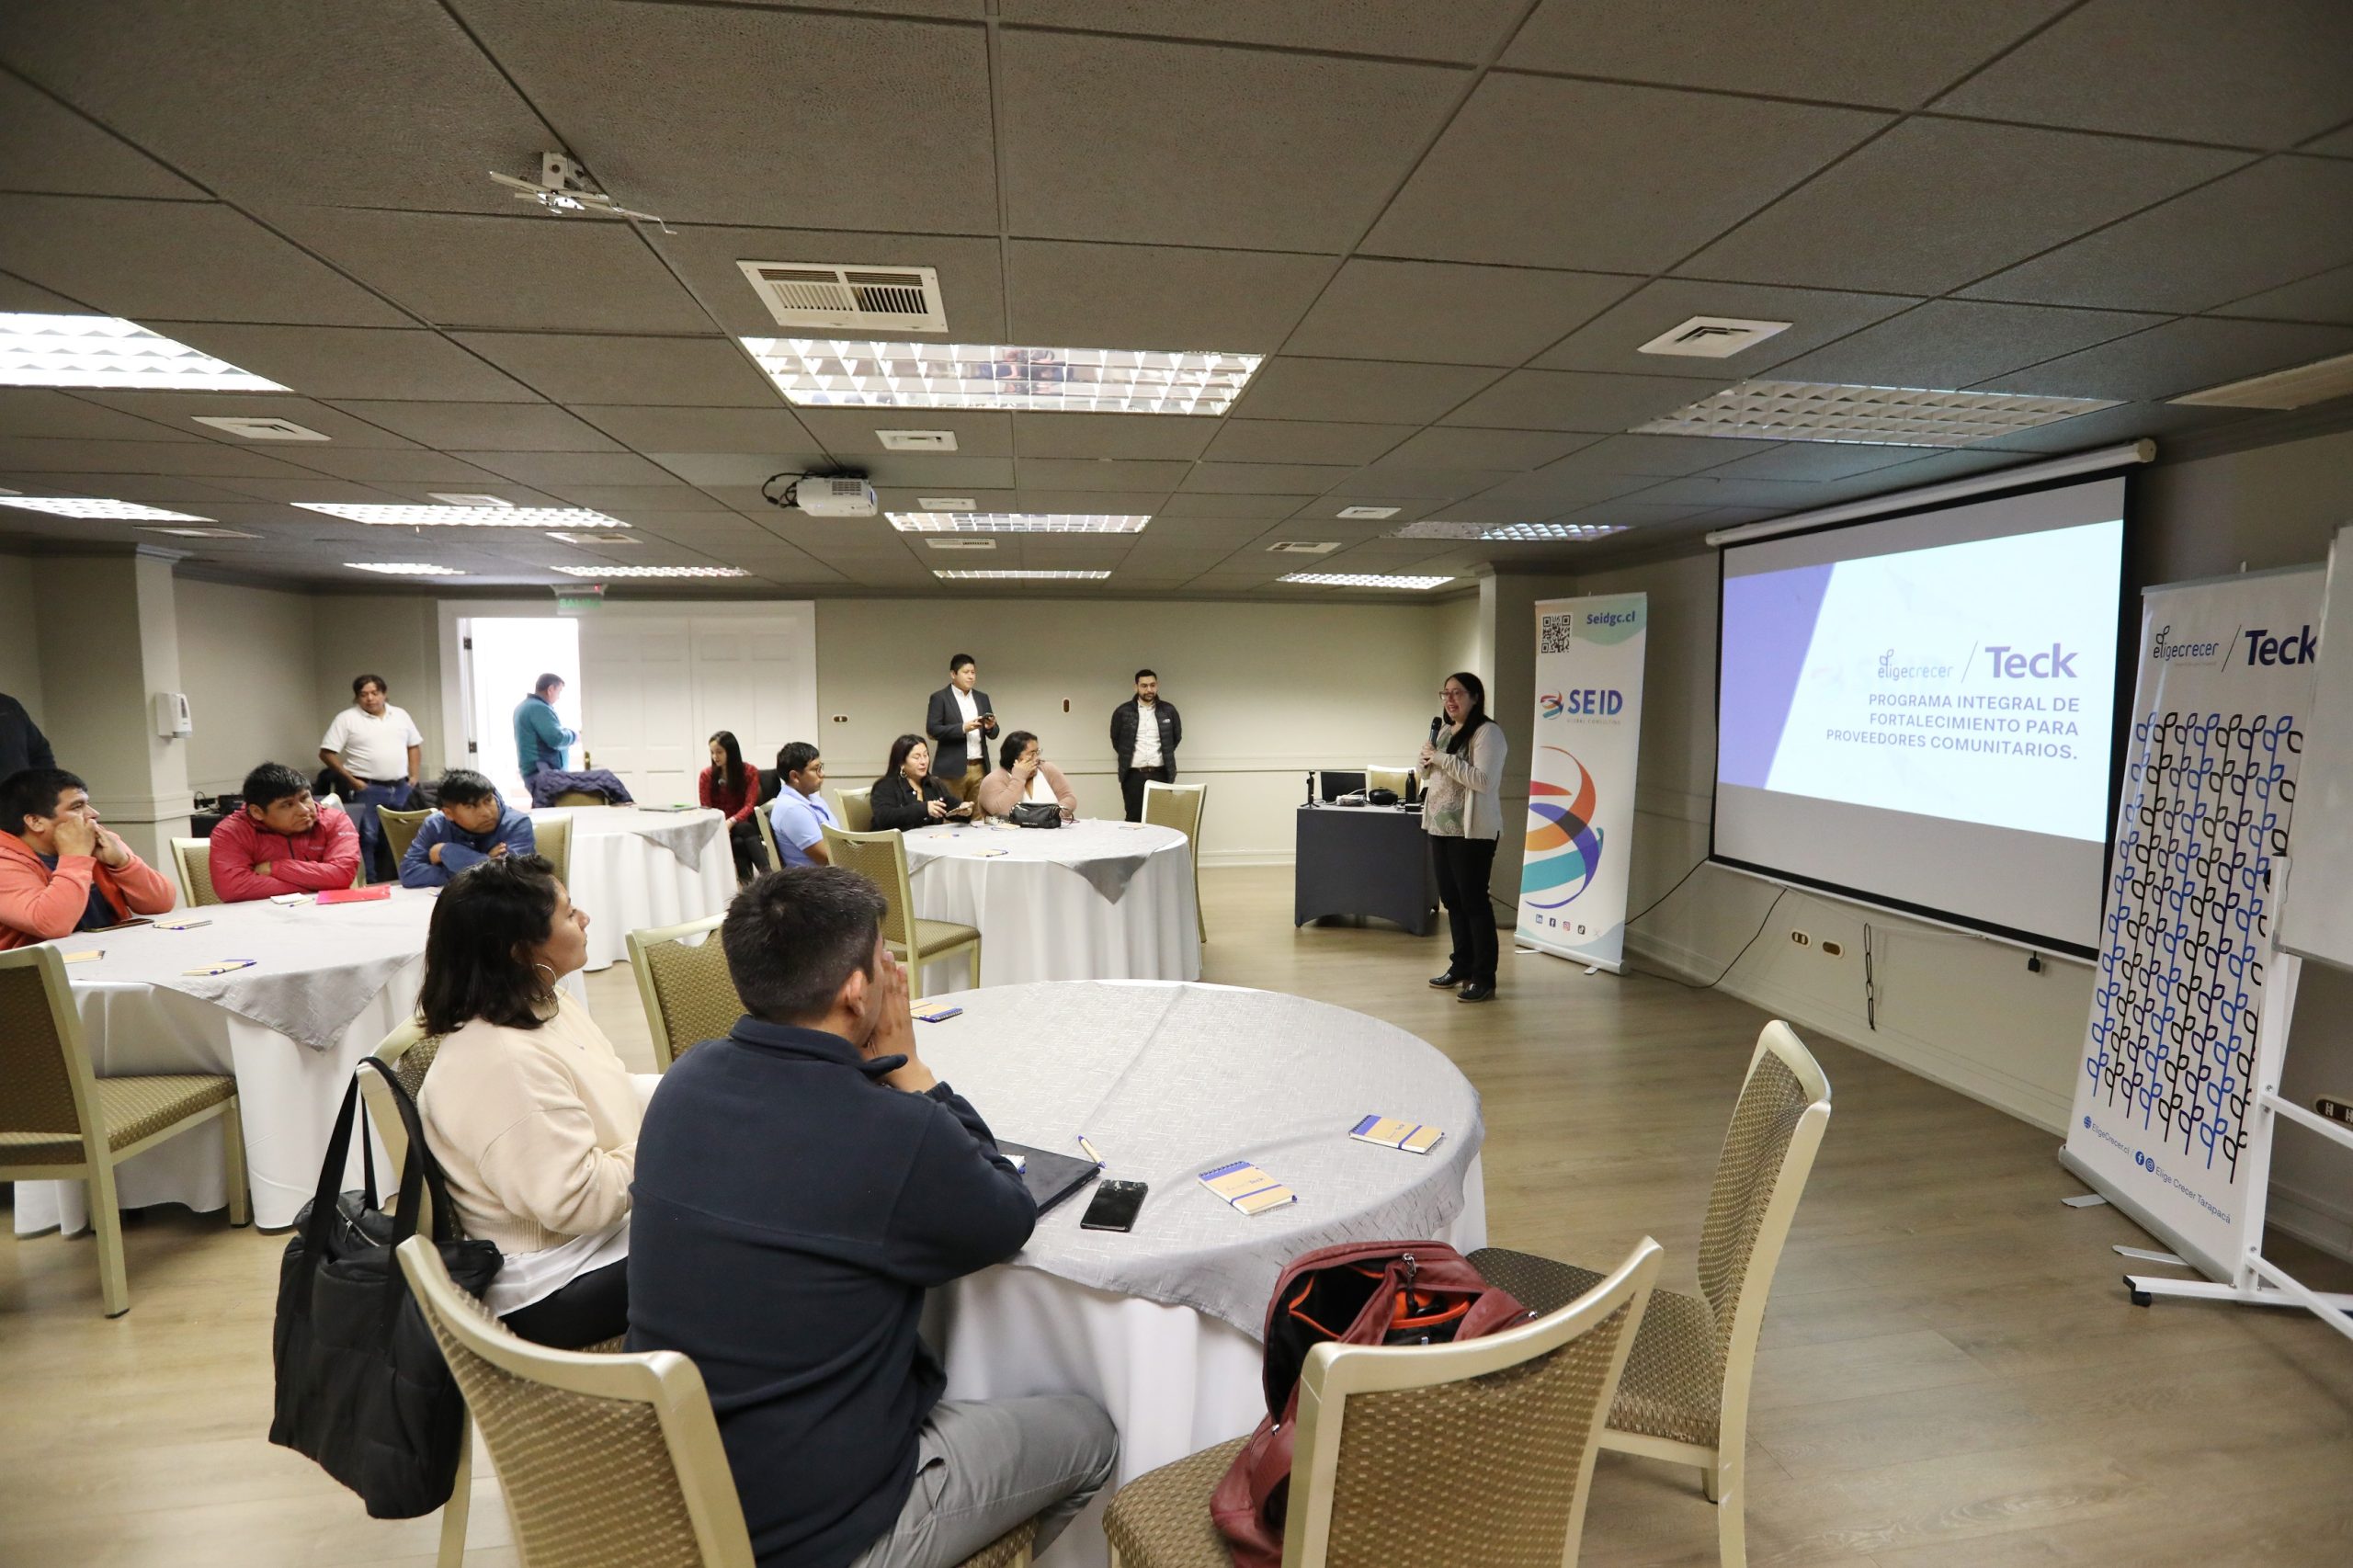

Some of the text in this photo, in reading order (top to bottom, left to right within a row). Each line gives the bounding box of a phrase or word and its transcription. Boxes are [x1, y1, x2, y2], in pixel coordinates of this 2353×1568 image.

[1586, 610, 1636, 626] Seidgc.cl
[2153, 625, 2317, 665] eligecrecer Teck
[1878, 642, 2079, 681] eligecrecer Teck
[1567, 689, 1623, 715] SEID
[1869, 694, 2080, 712] PROGRAMA INTEGRAL DE
[1870, 712, 2079, 736] FORTALECIMIENTO PARA
[1826, 729, 2078, 760] PROVEEDORES COMUNITARIOS.
[2155, 1166, 2172, 1184] Elige
[2173, 1178, 2196, 1199] Crecer
